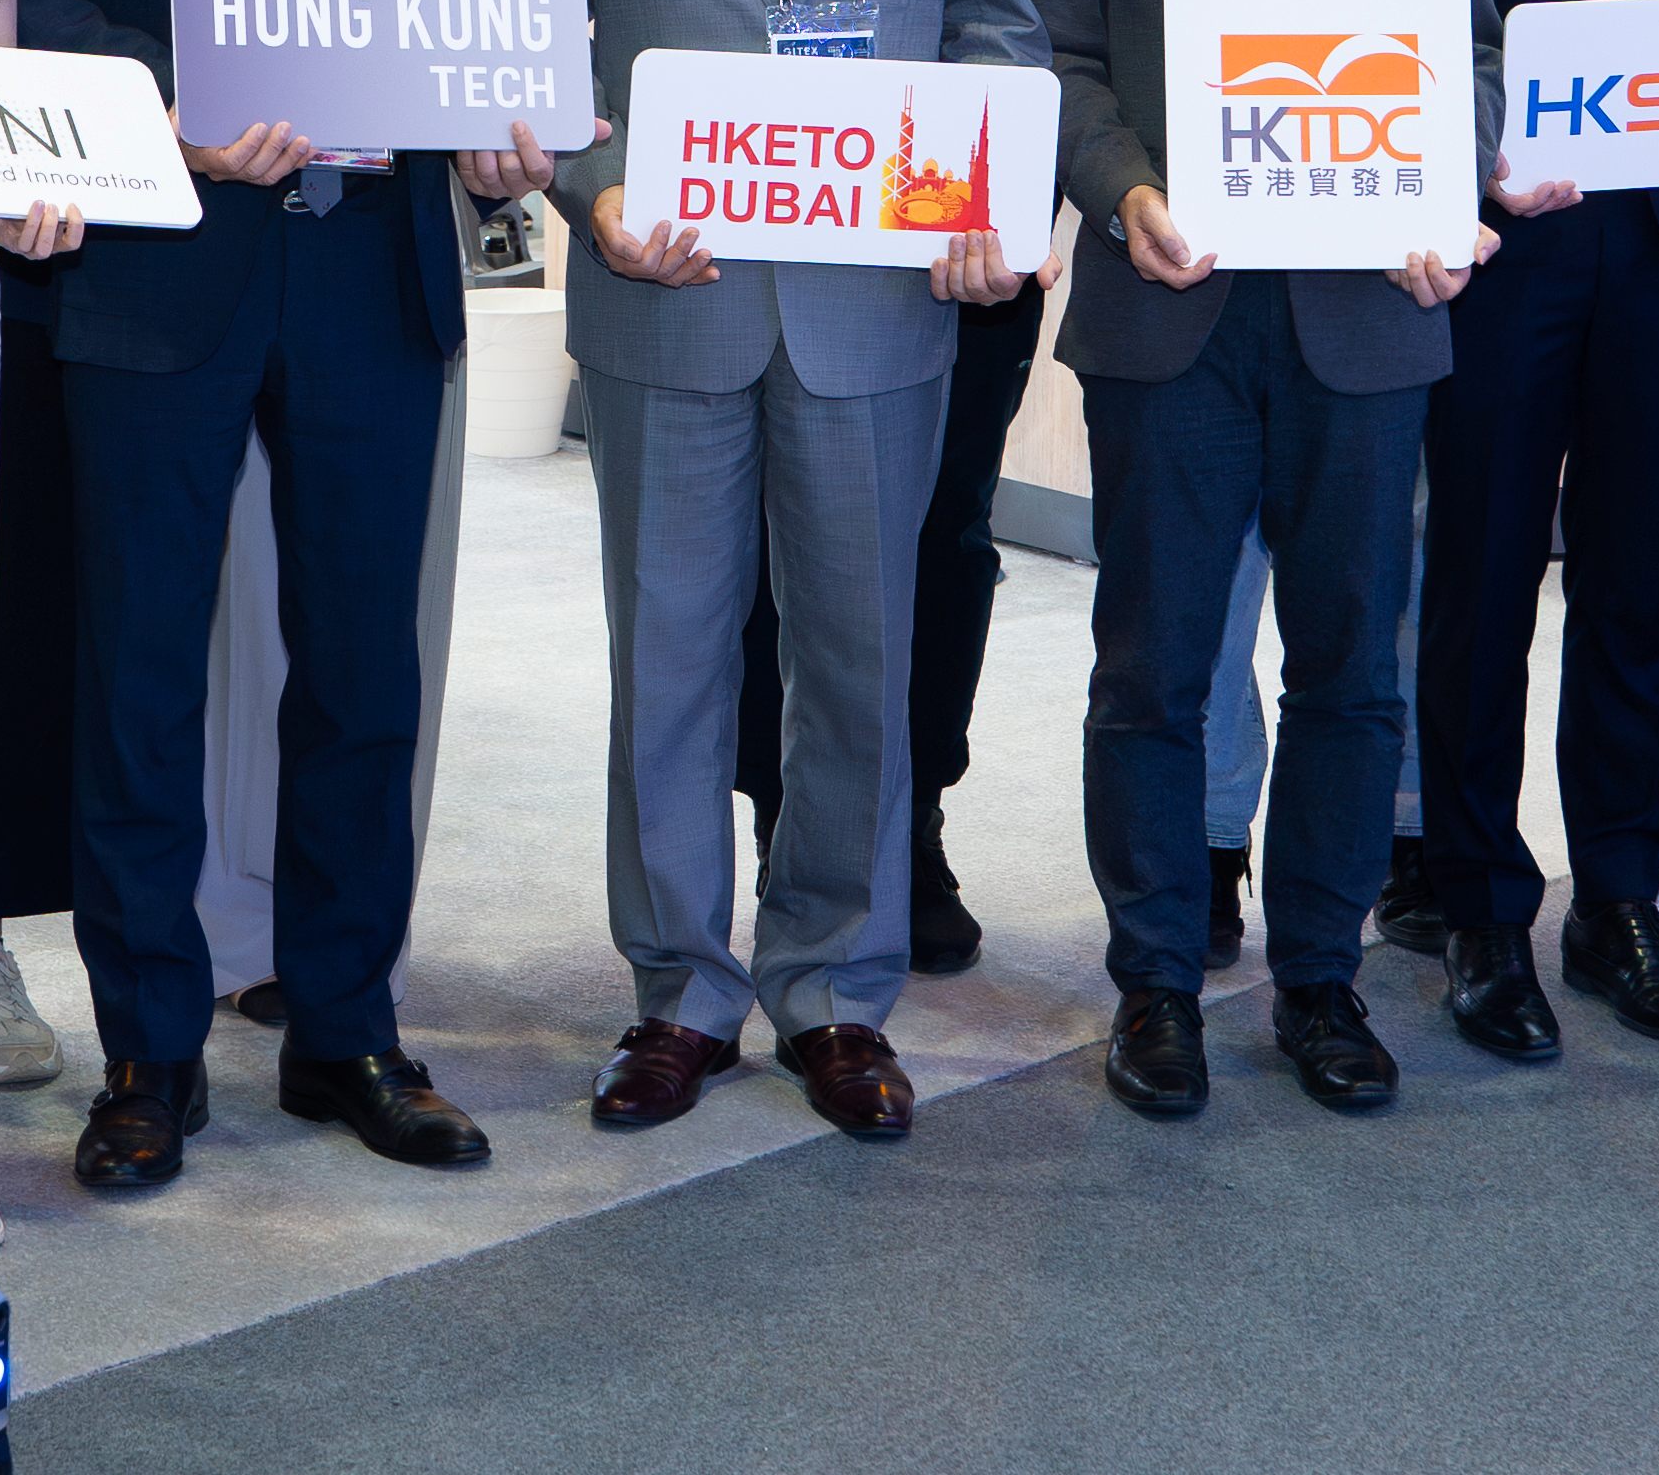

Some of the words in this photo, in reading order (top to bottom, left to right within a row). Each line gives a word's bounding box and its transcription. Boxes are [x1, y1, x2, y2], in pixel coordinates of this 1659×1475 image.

[430, 67, 555, 109] TECH
[683, 121, 874, 171] HKETO
[1222, 108, 1421, 163] HKTDC
[26, 170, 156, 191] Innovation
[1224, 169, 1422, 197] 香港貿發局
[679, 179, 861, 228] DUBAI
